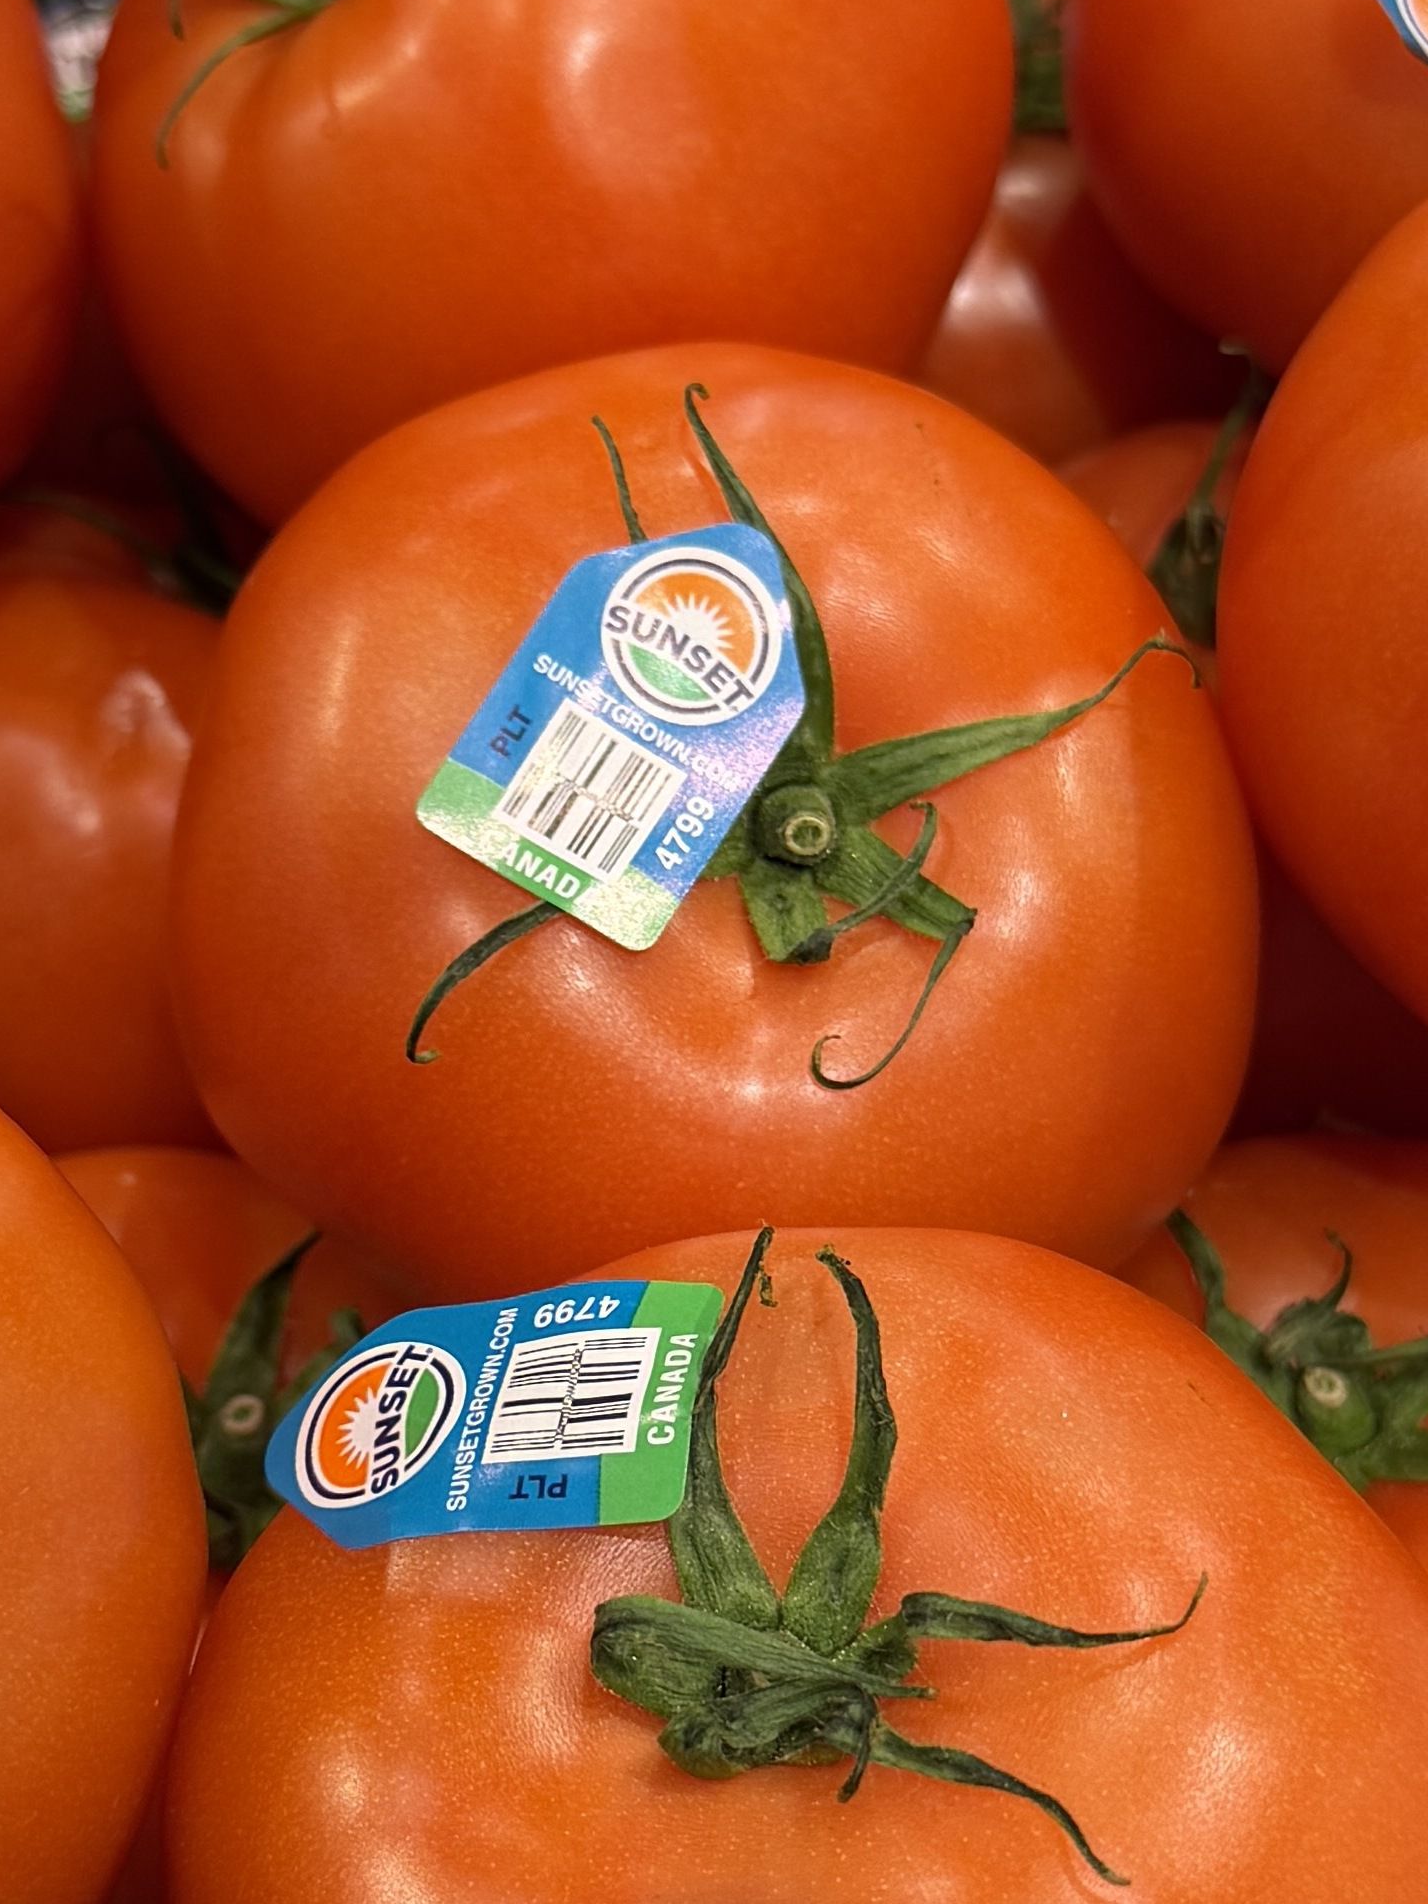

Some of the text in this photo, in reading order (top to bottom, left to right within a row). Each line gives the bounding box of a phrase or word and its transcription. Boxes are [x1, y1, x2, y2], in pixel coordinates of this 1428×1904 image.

[606, 605, 753, 708] SUNSET
[489, 703, 533, 758] PLT
[492, 838, 590, 904] ANAD
[655, 796, 714, 871] 4799
[534, 1296, 620, 1328] 4799
[372, 1345, 430, 1494] SUNSET
[446, 1308, 519, 1512] SUNSETGROWN.COM
[647, 1333, 699, 1445] CANADA
[509, 1474, 568, 1500] PLT
